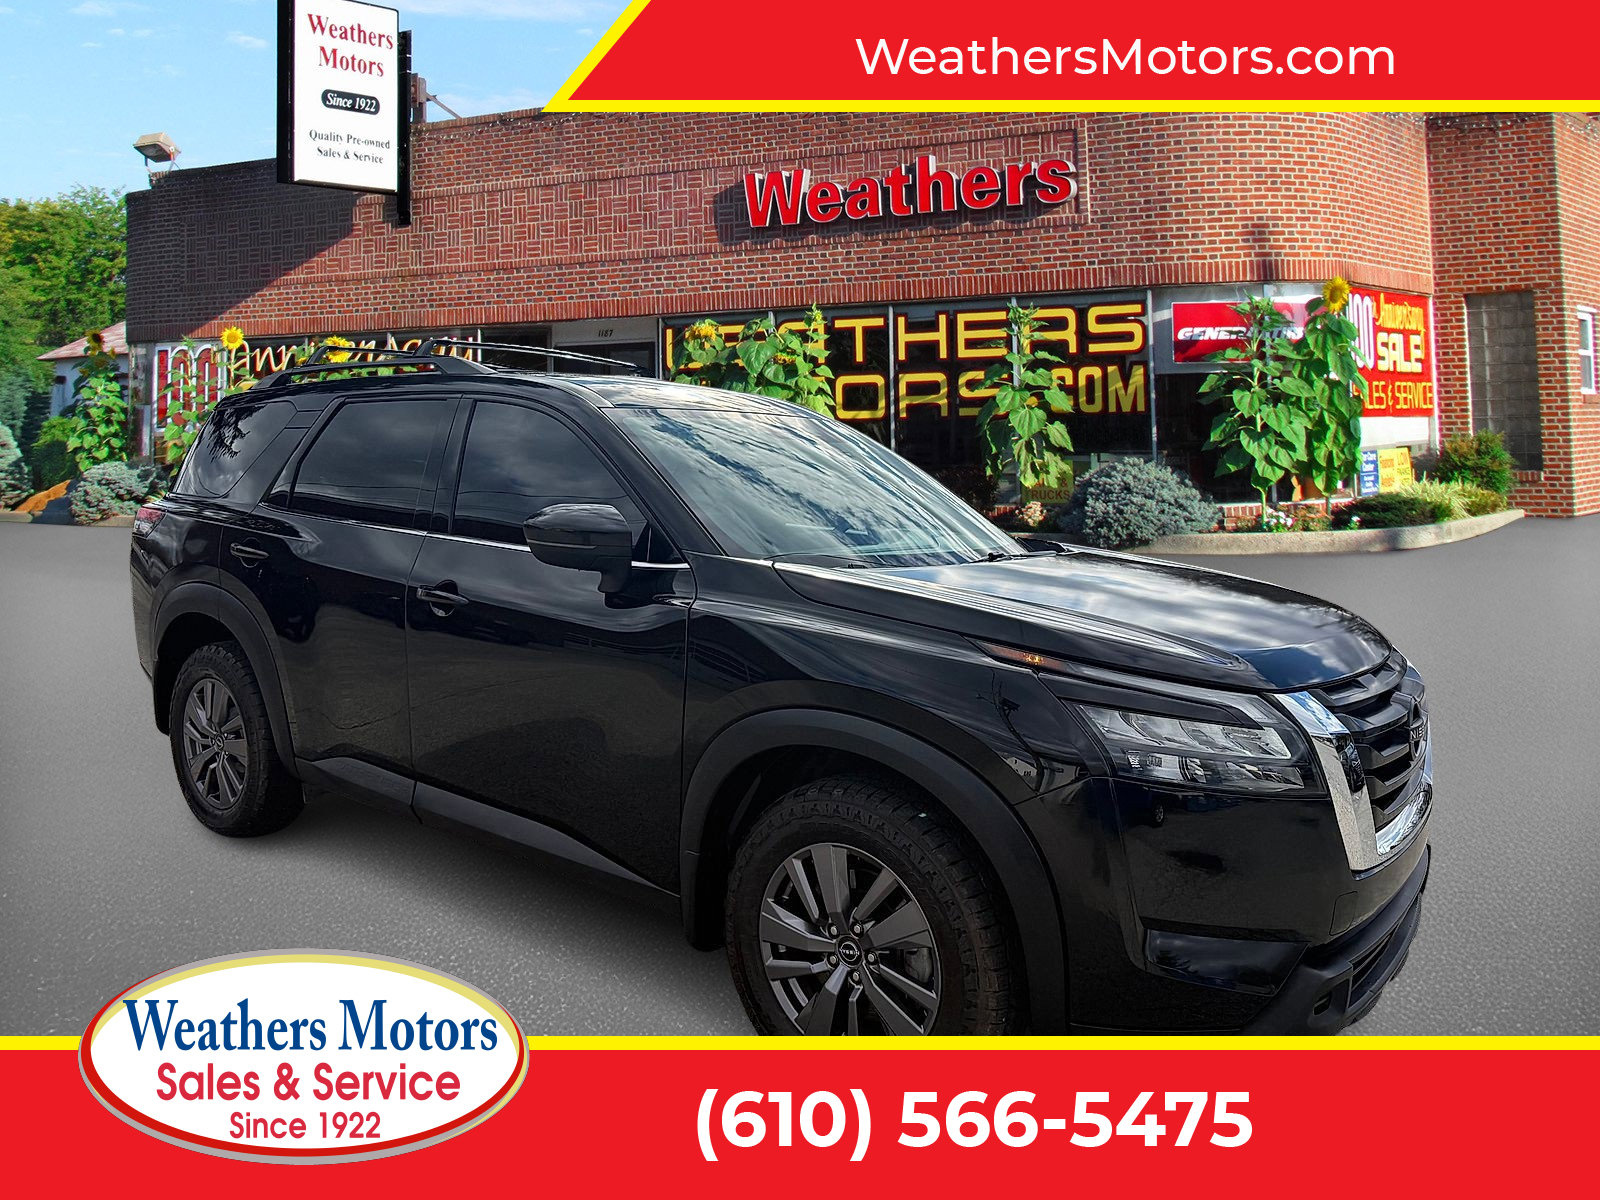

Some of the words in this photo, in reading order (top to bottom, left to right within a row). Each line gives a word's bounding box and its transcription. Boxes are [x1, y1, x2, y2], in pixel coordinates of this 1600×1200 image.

[307, 13, 393, 50] Weathers
[319, 45, 384, 77] Motors
[326, 92, 352, 109] Since
[355, 97, 376, 112] 1922
[309, 129, 343, 145] Quality
[346, 133, 390, 149] Pre-owned
[317, 146, 341, 158] Sales
[343, 150, 350, 160] &
[353, 151, 383, 164] Service
[743, 155, 1077, 228] Weathers
[598, 329, 614, 337] 1187
[1177, 326, 1305, 341] GENERORS
[1376, 331, 1423, 373] SALE
[1353, 381, 1387, 409] LES
[1395, 381, 1434, 409] SERVICE
